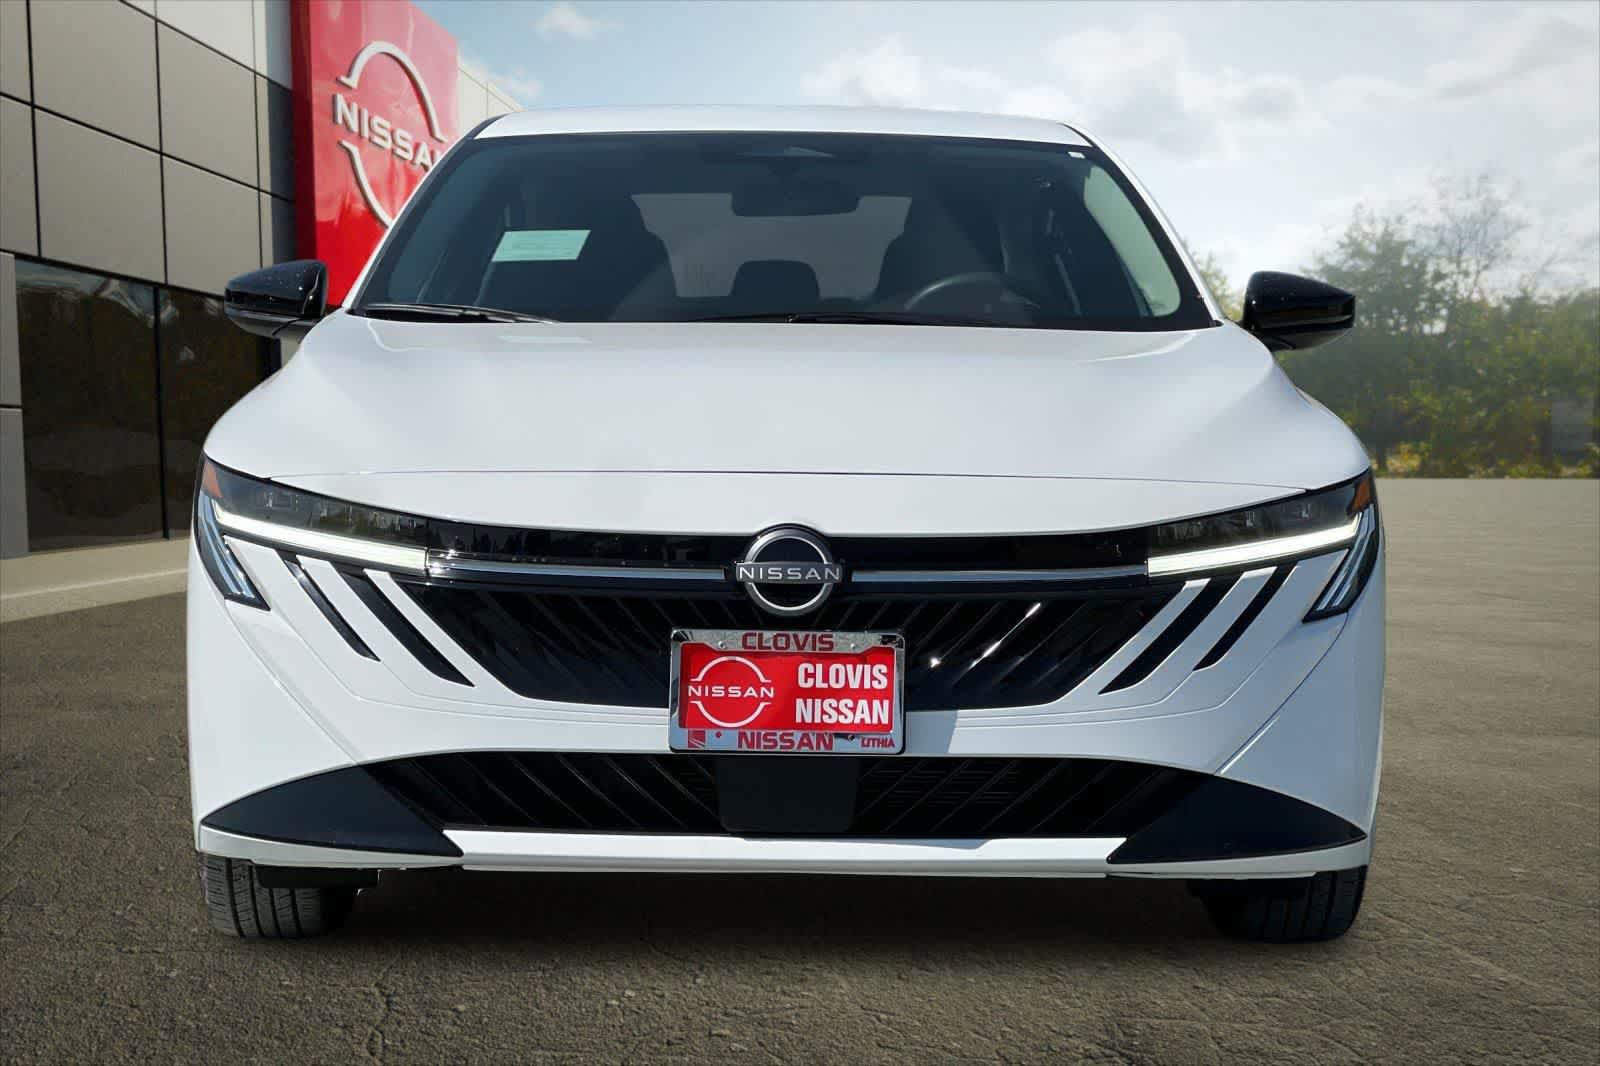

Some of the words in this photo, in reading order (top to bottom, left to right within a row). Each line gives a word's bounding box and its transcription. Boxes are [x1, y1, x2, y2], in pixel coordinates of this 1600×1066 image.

[739, 566, 840, 581] NISSAN
[741, 632, 835, 652] CLOVIS
[797, 663, 888, 690] CLOVIS
[688, 685, 775, 699] NISSAN
[795, 699, 889, 725] NISSAN
[737, 730, 834, 751] NISSAN
[860, 735, 896, 748] LITHIA
